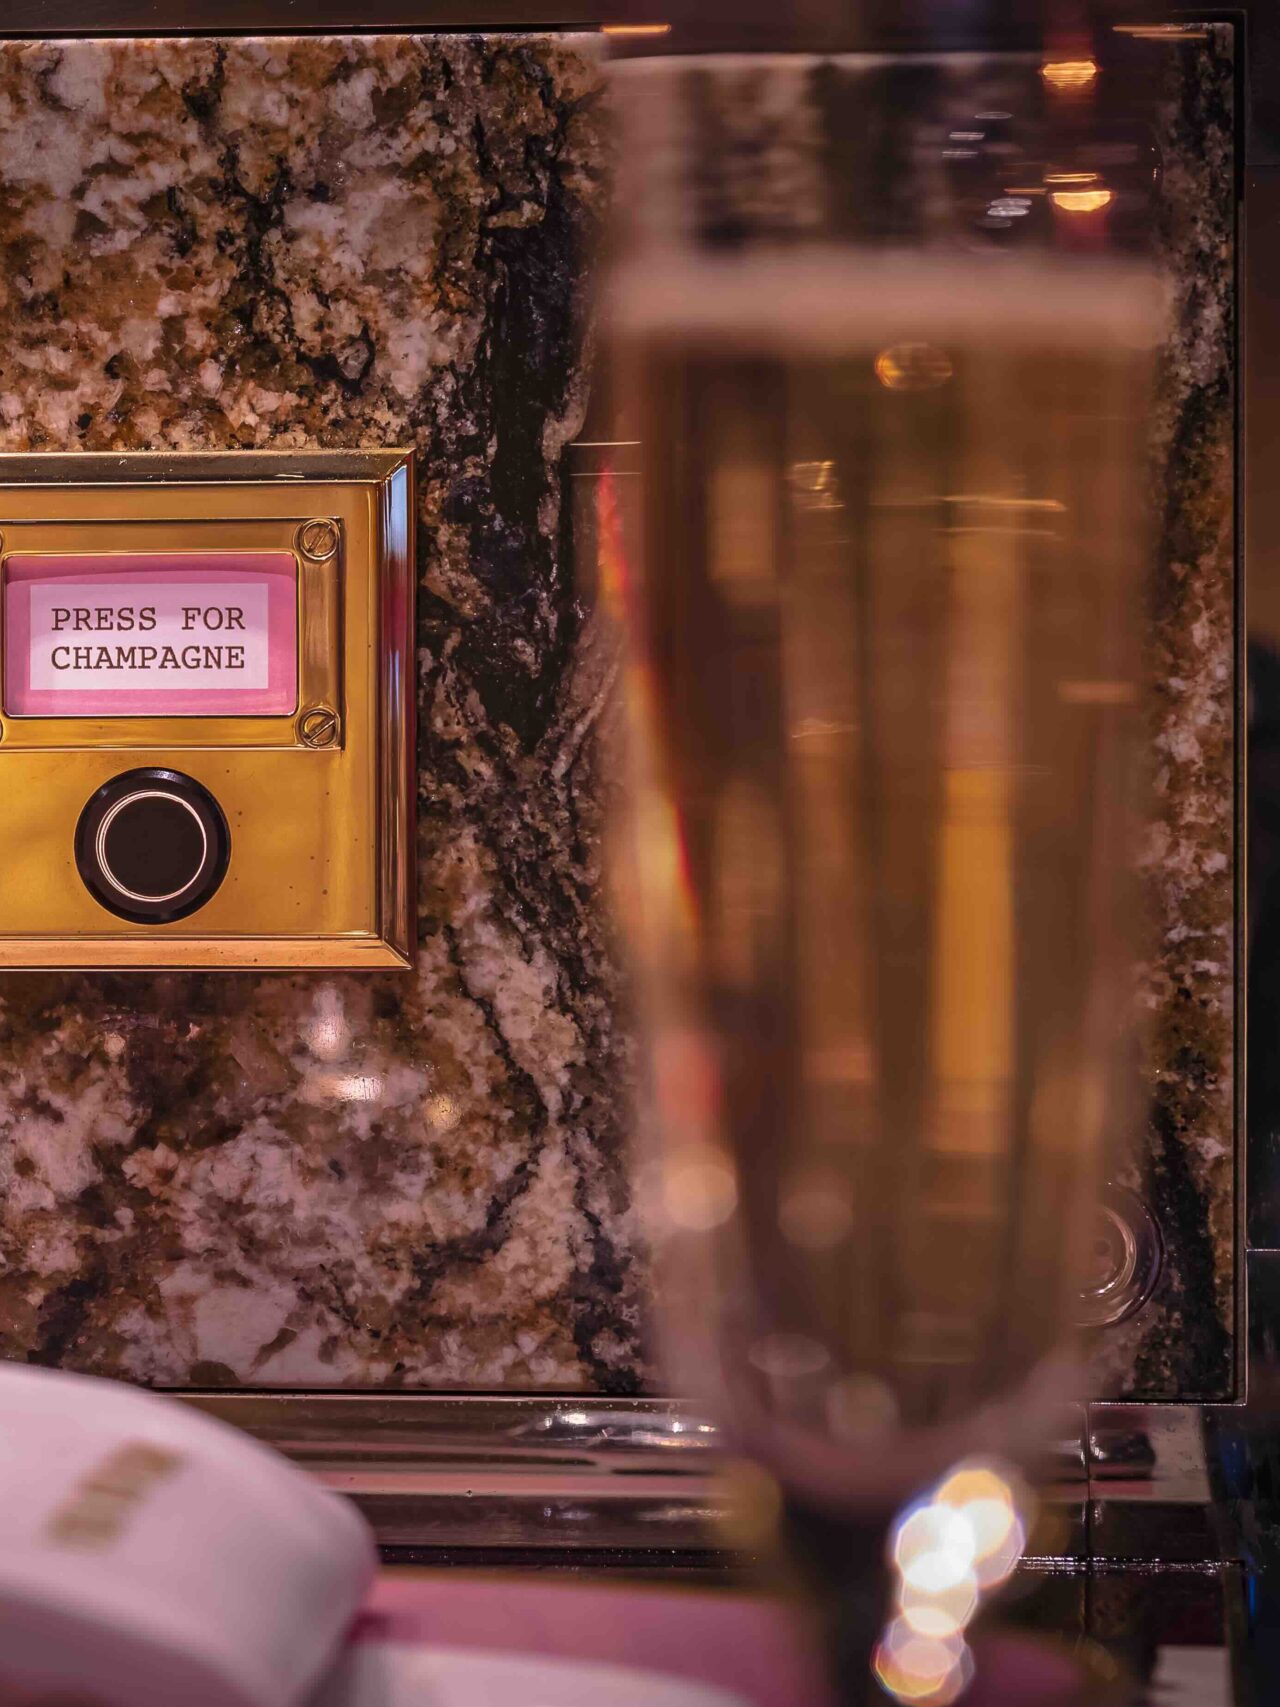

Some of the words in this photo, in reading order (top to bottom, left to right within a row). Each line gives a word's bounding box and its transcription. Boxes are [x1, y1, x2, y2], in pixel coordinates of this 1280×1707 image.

[51, 606, 157, 632] PRESS
[181, 606, 246, 631] FOR
[50, 645, 245, 670] CHAMPAGNE
